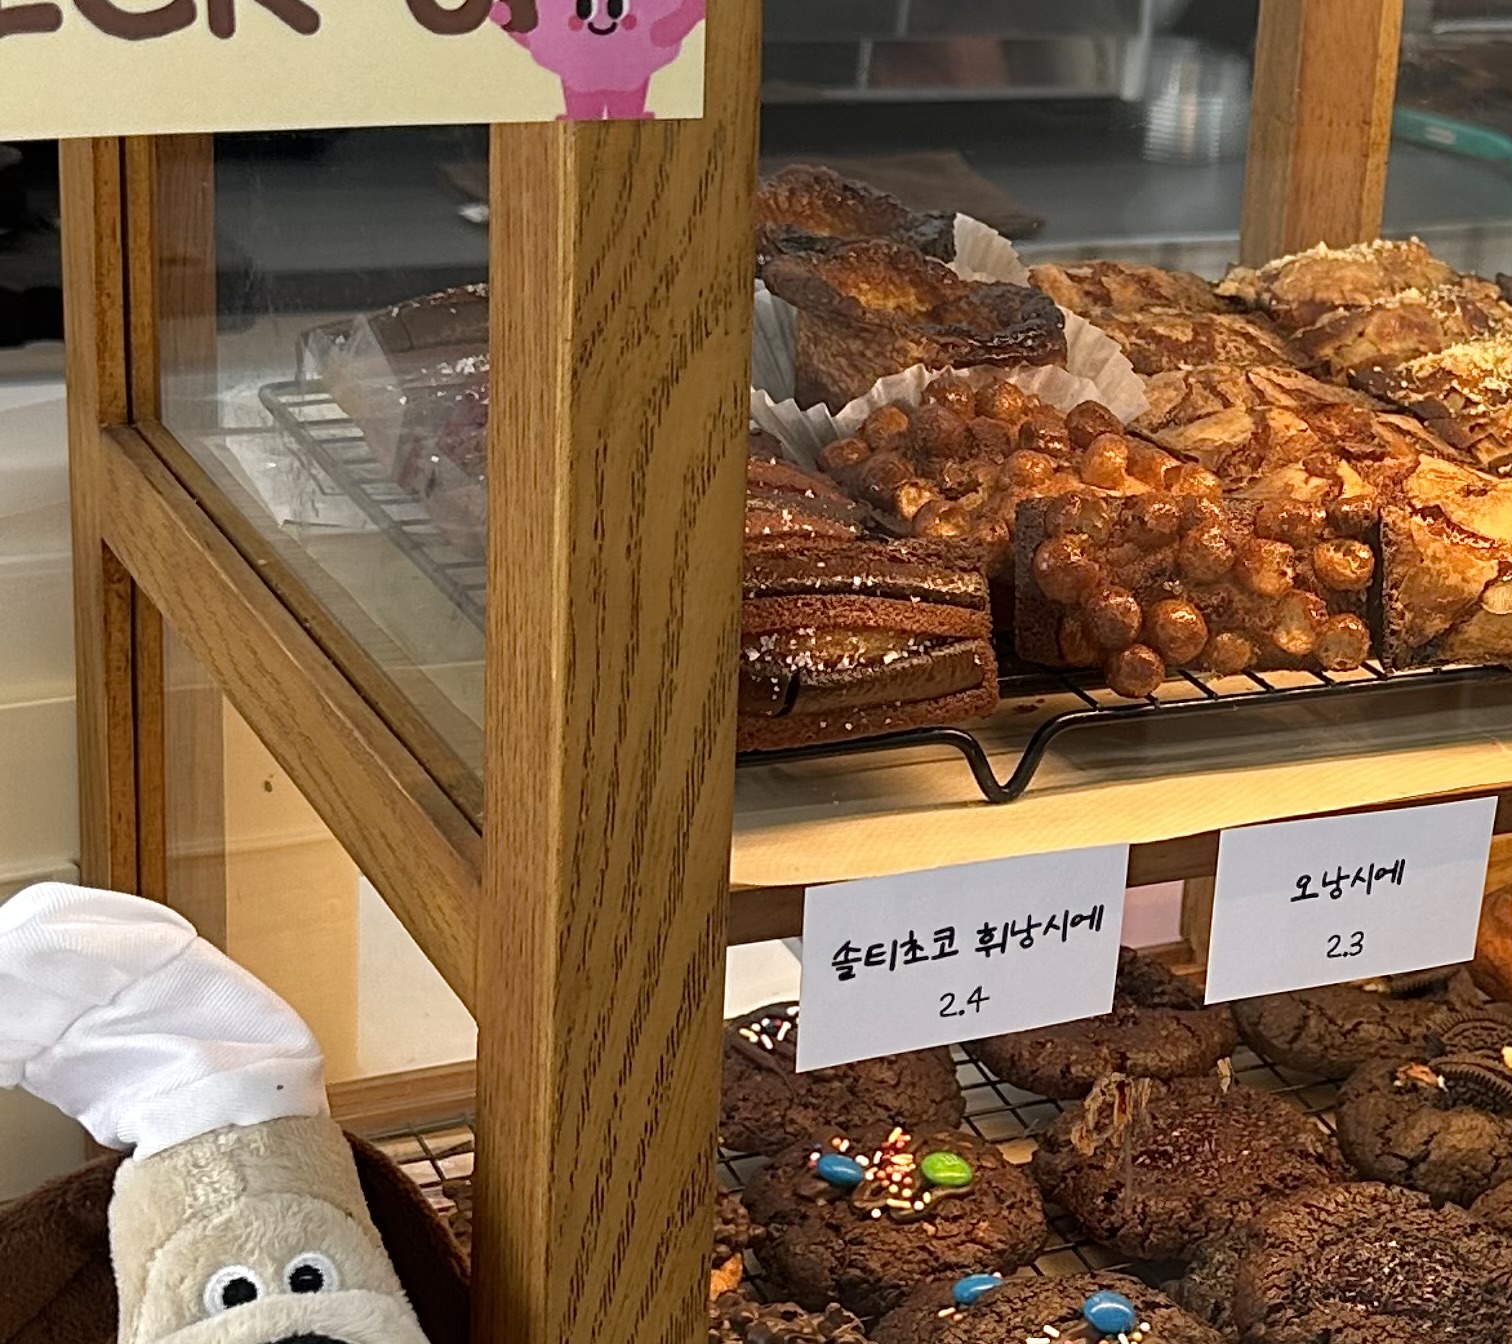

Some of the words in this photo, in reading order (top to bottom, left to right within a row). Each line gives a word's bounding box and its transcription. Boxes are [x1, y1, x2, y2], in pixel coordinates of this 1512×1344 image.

[1290, 858, 1406, 902] 오낭시에
[831, 926, 959, 981] 솔티초코
[974, 904, 1104, 958] 휘낭시에
[1326, 930, 1365, 958] 2.3
[939, 986, 990, 1017] 2.4
